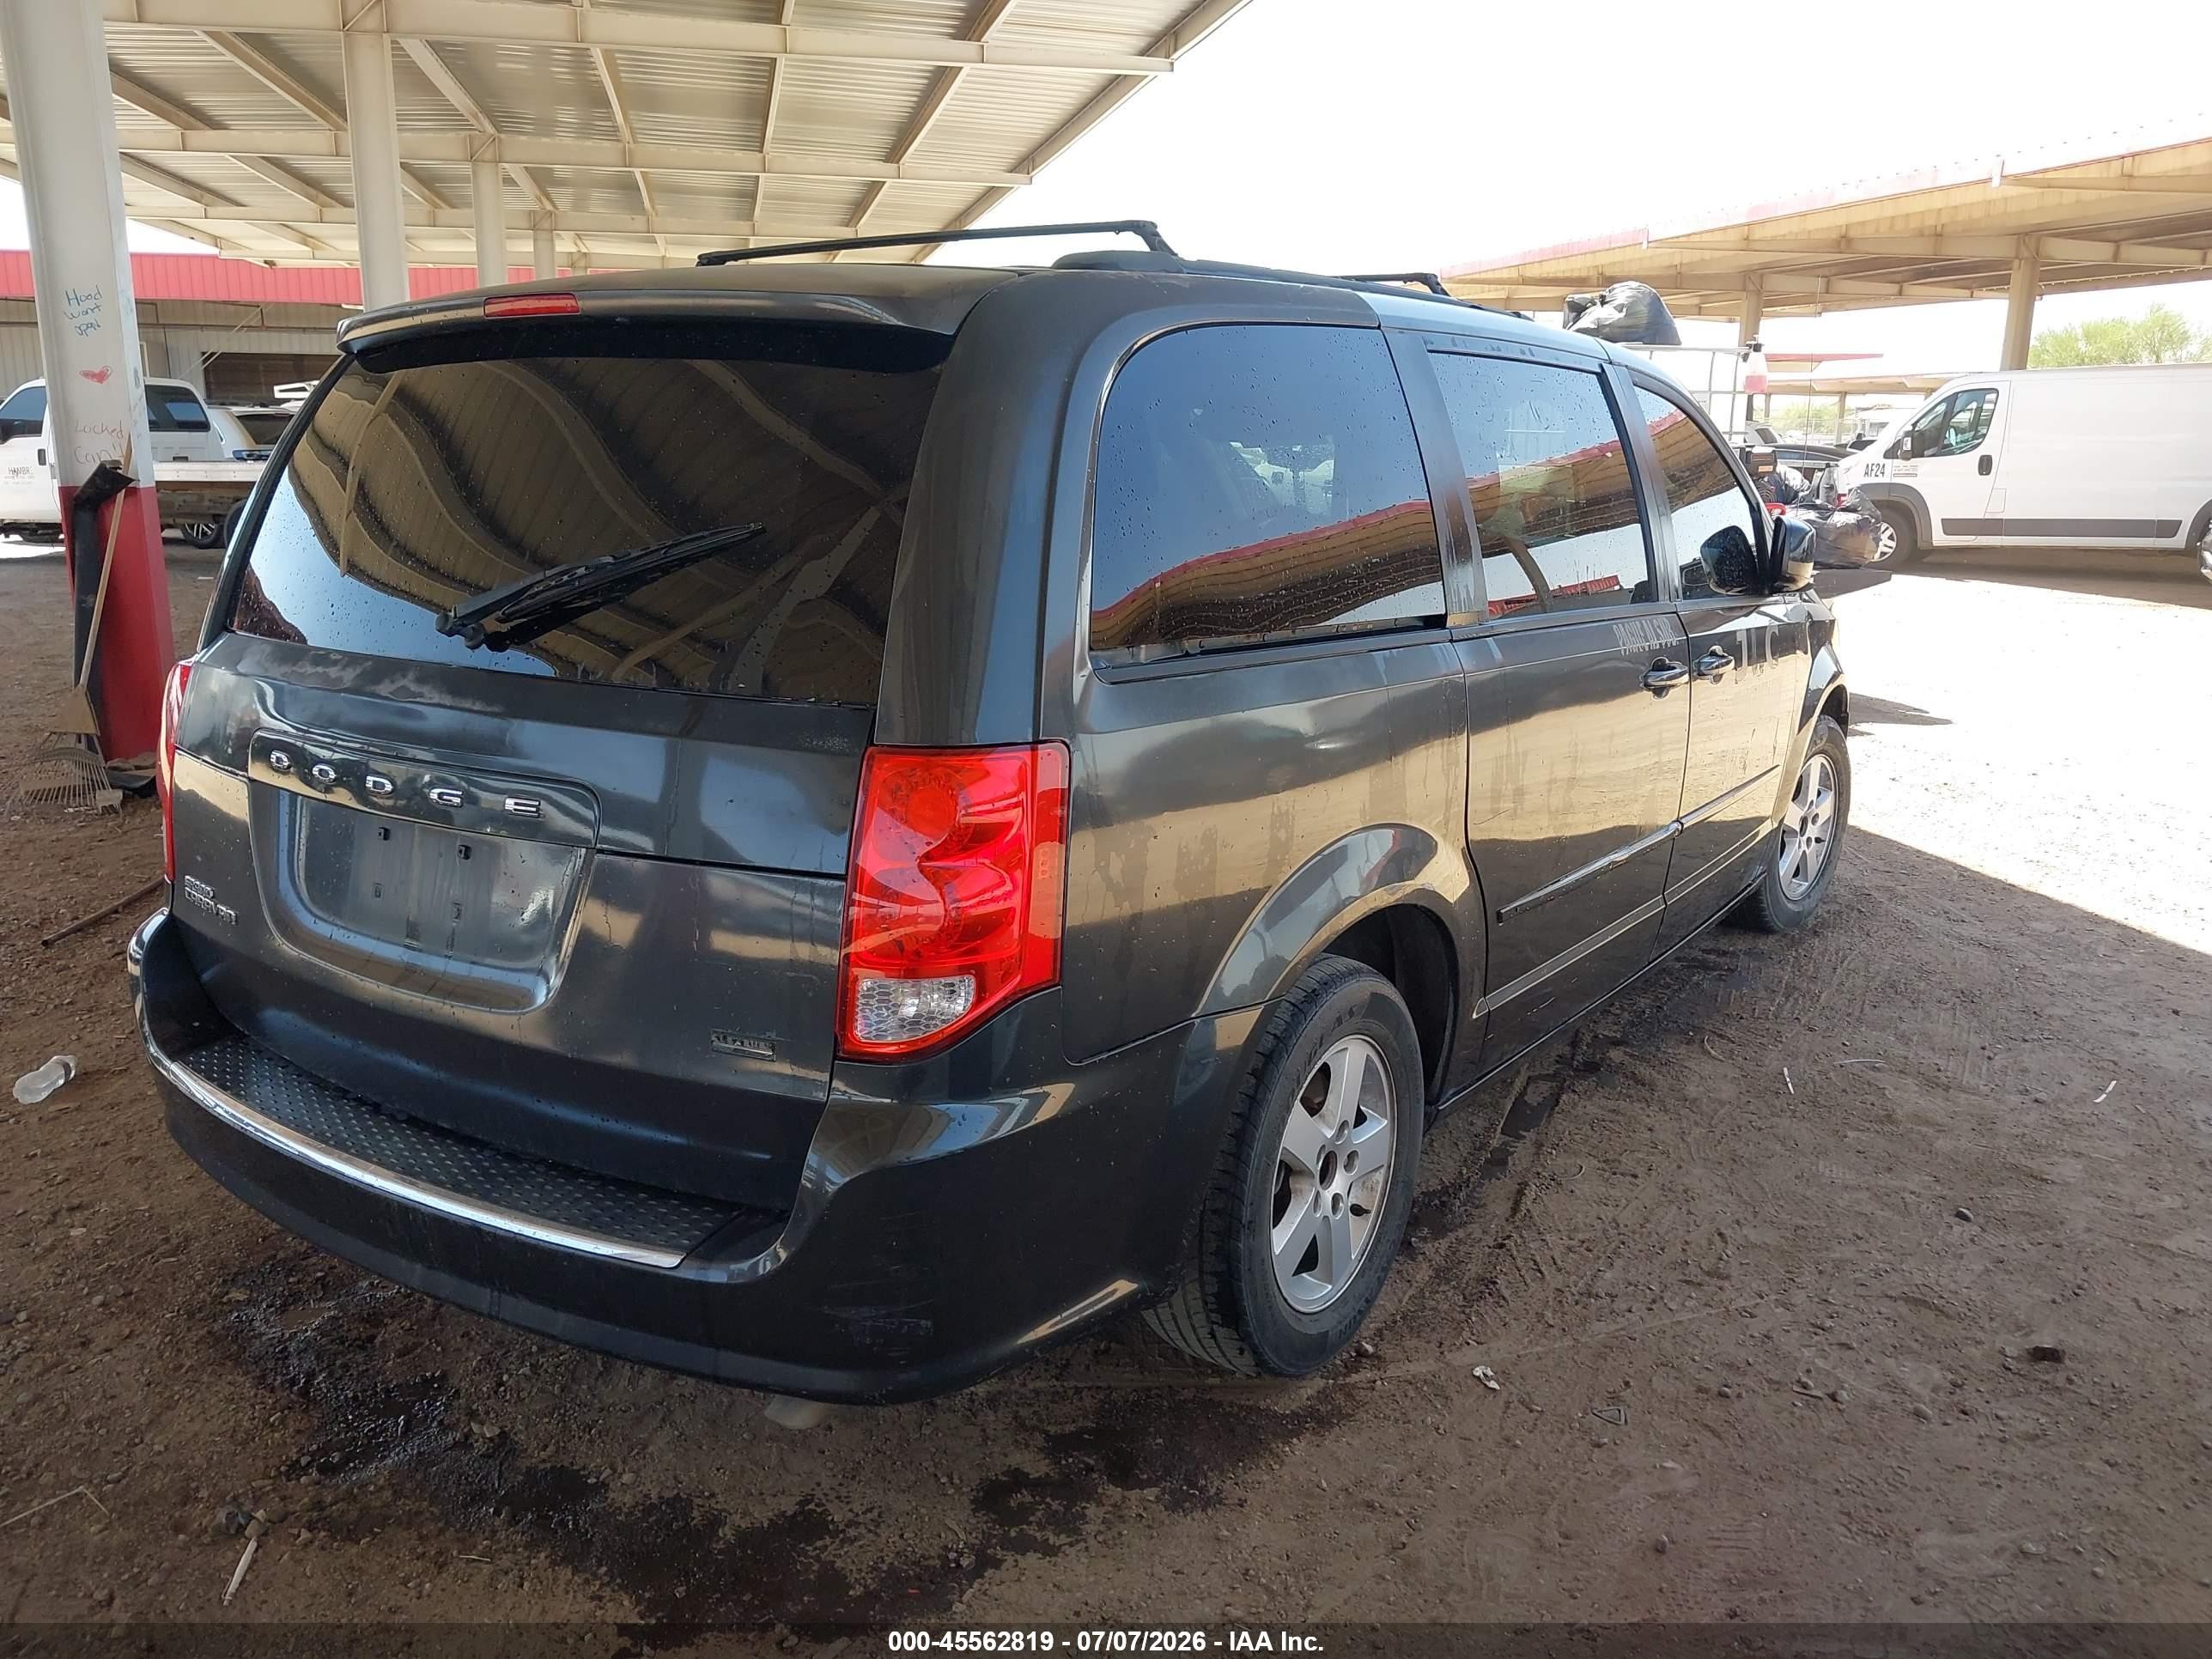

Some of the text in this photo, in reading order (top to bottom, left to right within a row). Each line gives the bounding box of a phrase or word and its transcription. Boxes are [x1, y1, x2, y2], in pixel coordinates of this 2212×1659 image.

[64, 284, 103, 307] Hood
[76, 419, 124, 440] Locked
[1864, 463, 1886, 477] AF24
[269, 749, 545, 818] DODGE
